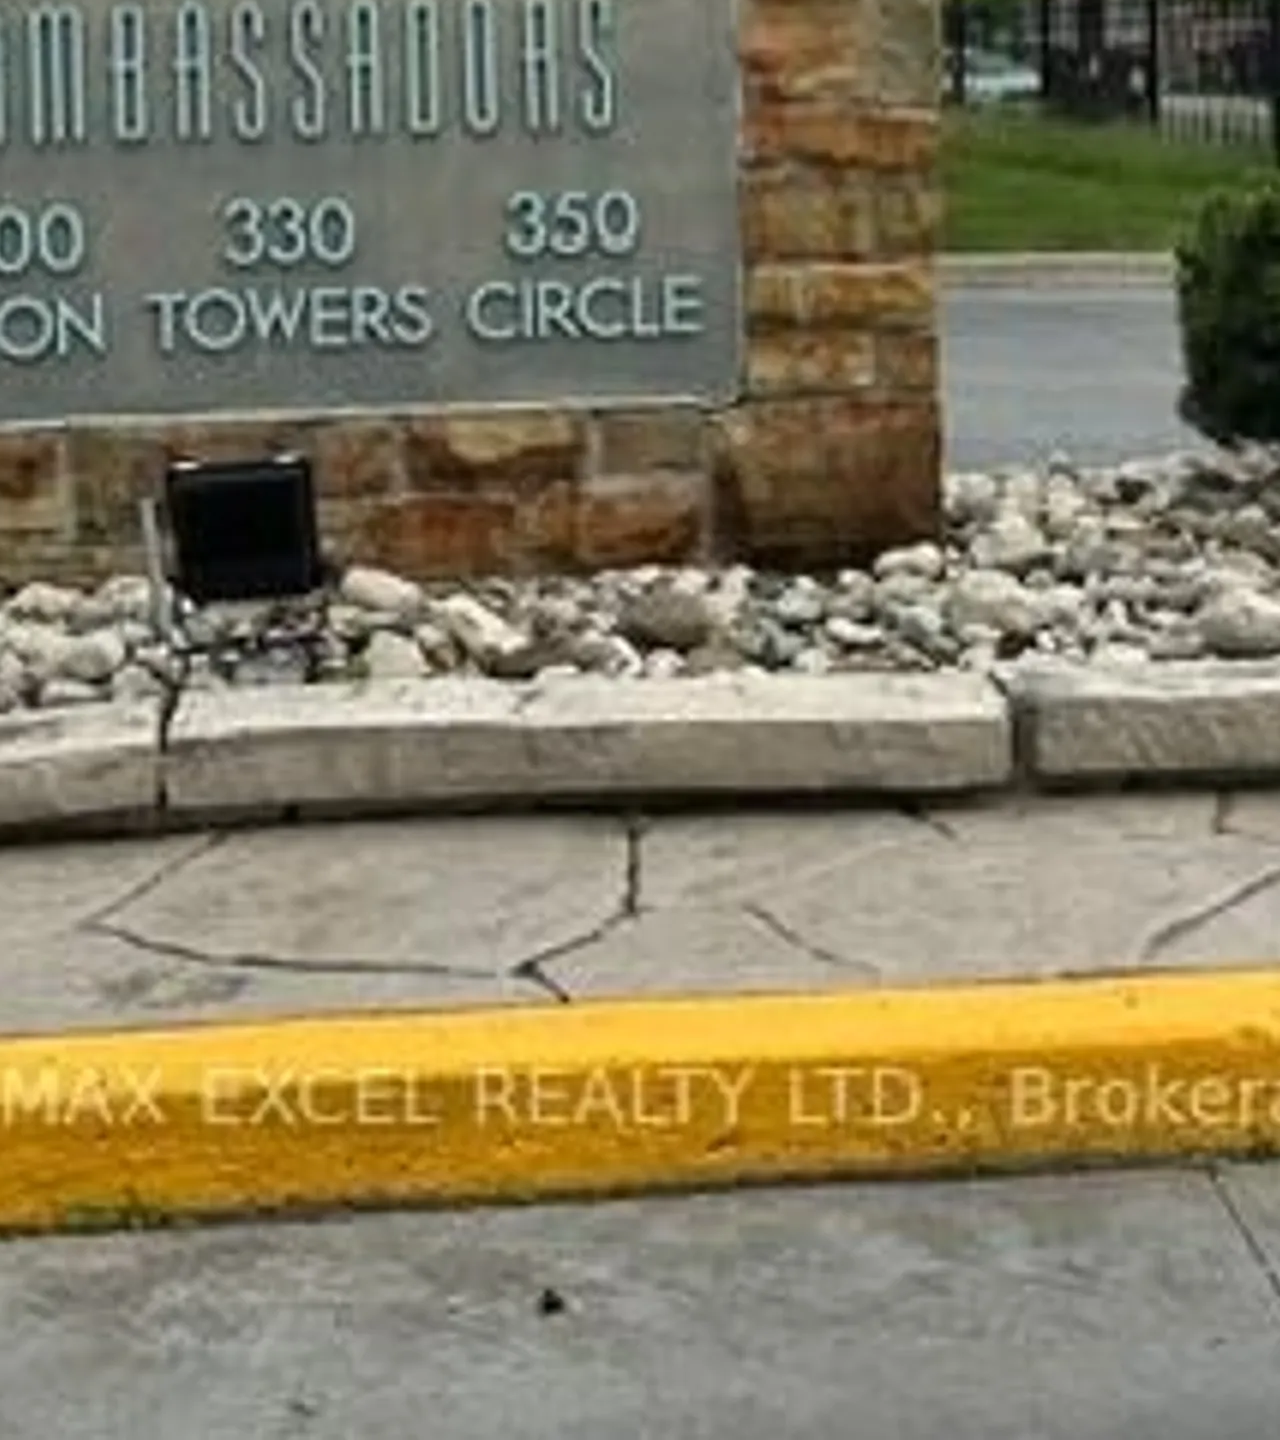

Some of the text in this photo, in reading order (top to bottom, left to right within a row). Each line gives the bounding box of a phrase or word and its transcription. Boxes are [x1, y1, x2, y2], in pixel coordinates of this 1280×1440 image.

[222, 196, 356, 265] 330
[505, 189, 638, 257] 350
[147, 285, 434, 351] TOWERS
[465, 274, 704, 341] CIRCLE
